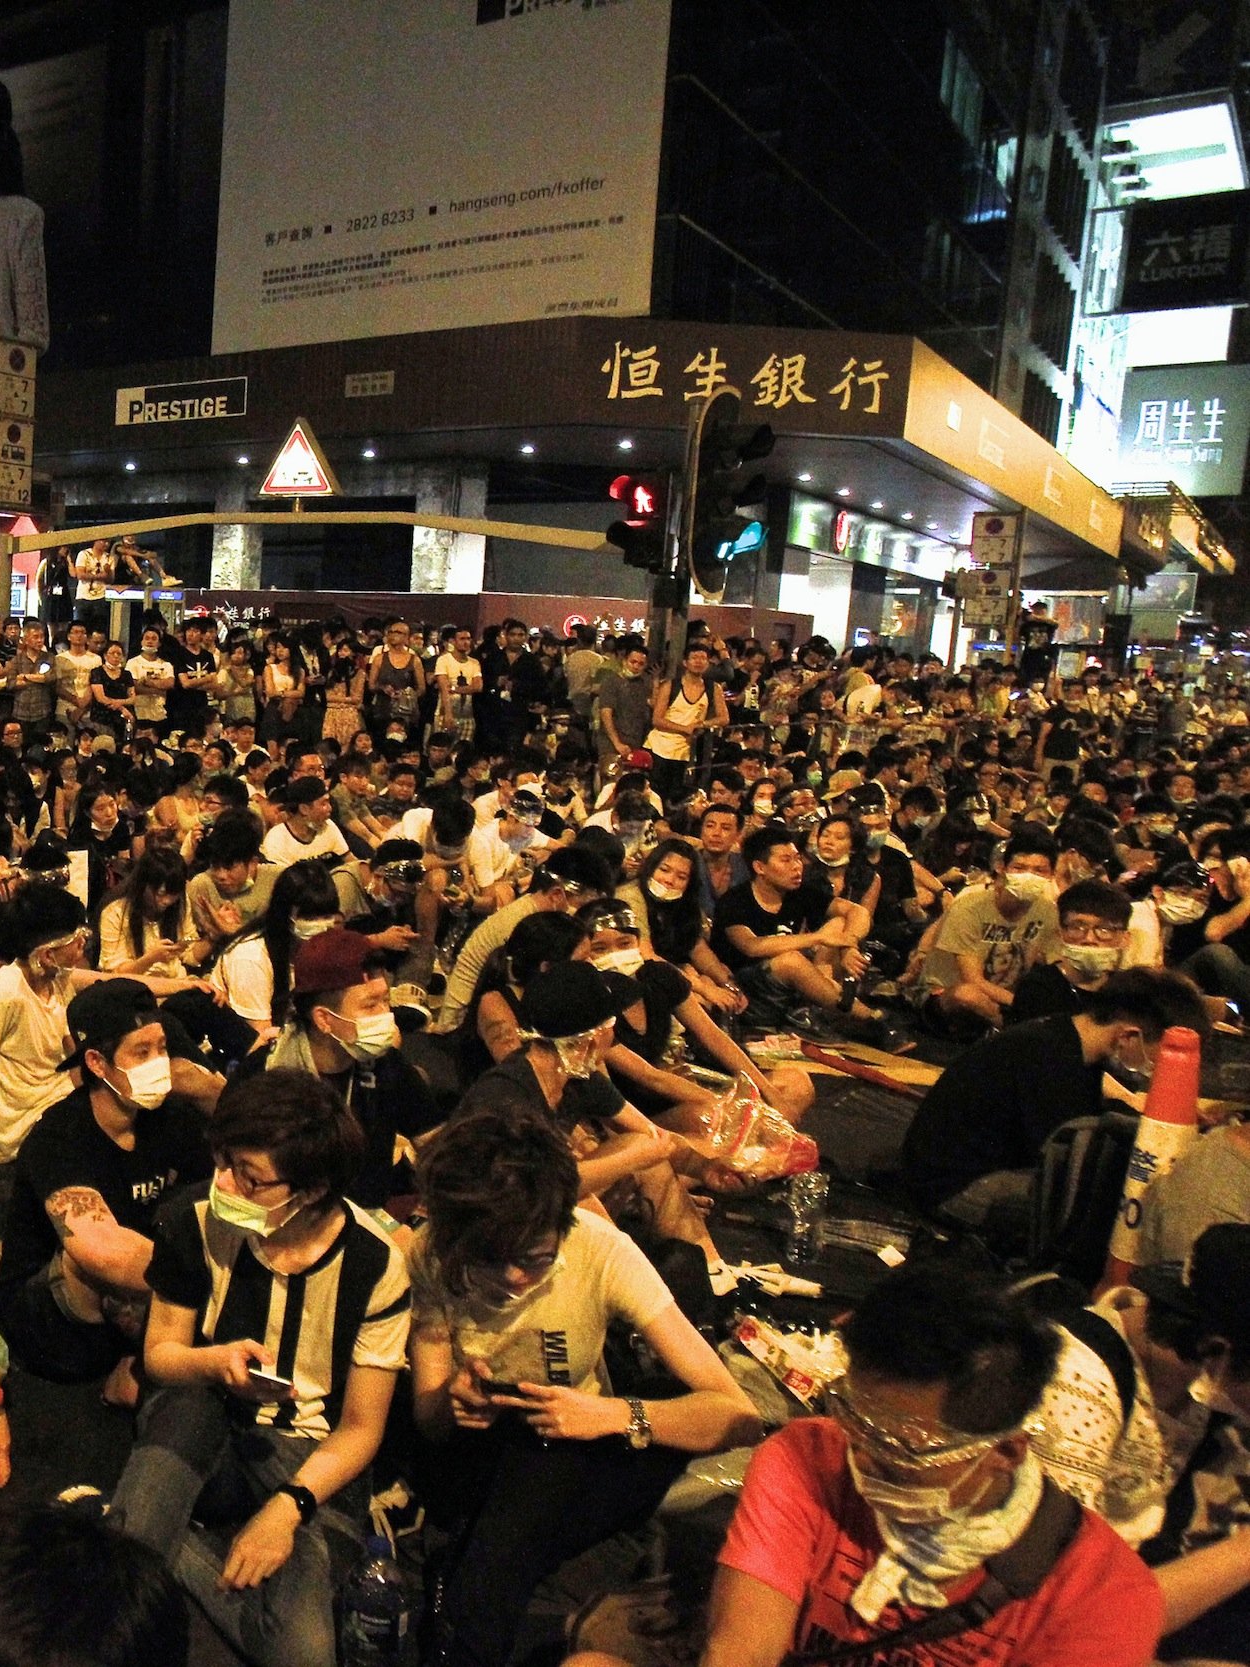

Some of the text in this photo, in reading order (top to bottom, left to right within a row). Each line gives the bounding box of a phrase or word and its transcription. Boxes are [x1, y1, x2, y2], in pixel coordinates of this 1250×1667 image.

[346, 215, 378, 233] 2822
[381, 208, 415, 227] 8233
[449, 177, 606, 213] hangseng.com/fxoffer
[601, 340, 890, 414] 恒生銀行
[129, 396, 228, 423] PRESTIGE
[1133, 398, 1226, 446] 周生生
